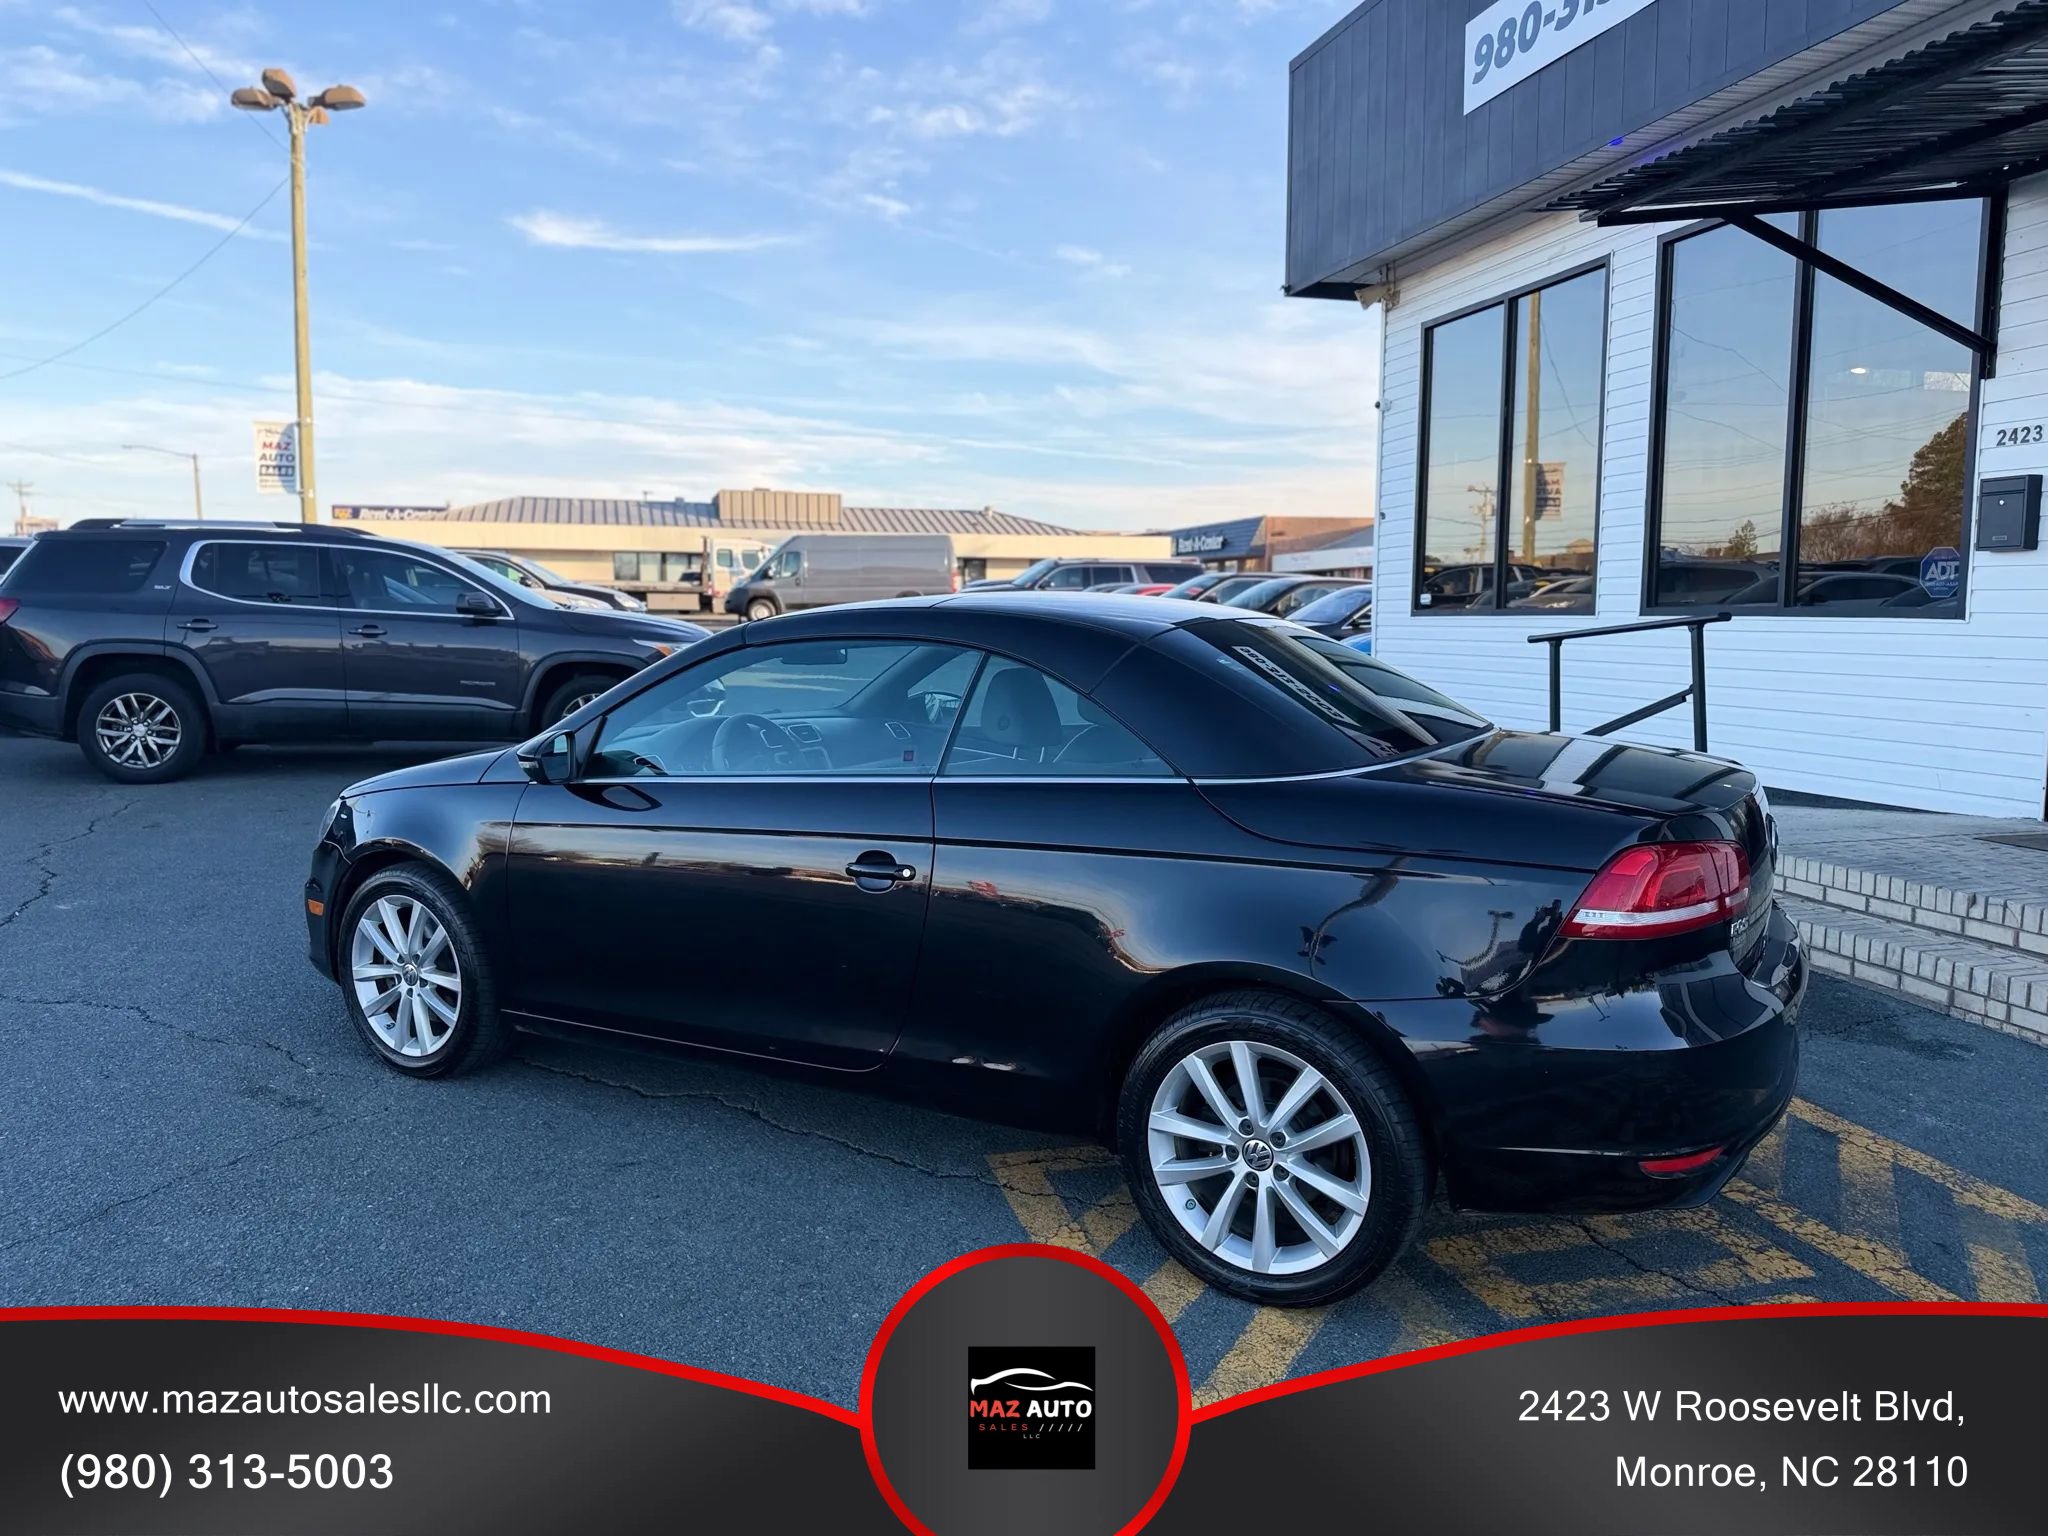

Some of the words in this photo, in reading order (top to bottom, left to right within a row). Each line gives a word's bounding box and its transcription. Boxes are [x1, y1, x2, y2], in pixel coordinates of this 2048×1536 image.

[1996, 424, 2043, 446] 2423
[263, 441, 291, 451] MAZ
[259, 453, 295, 463] AUTO
[1924, 560, 1960, 581] ADT
